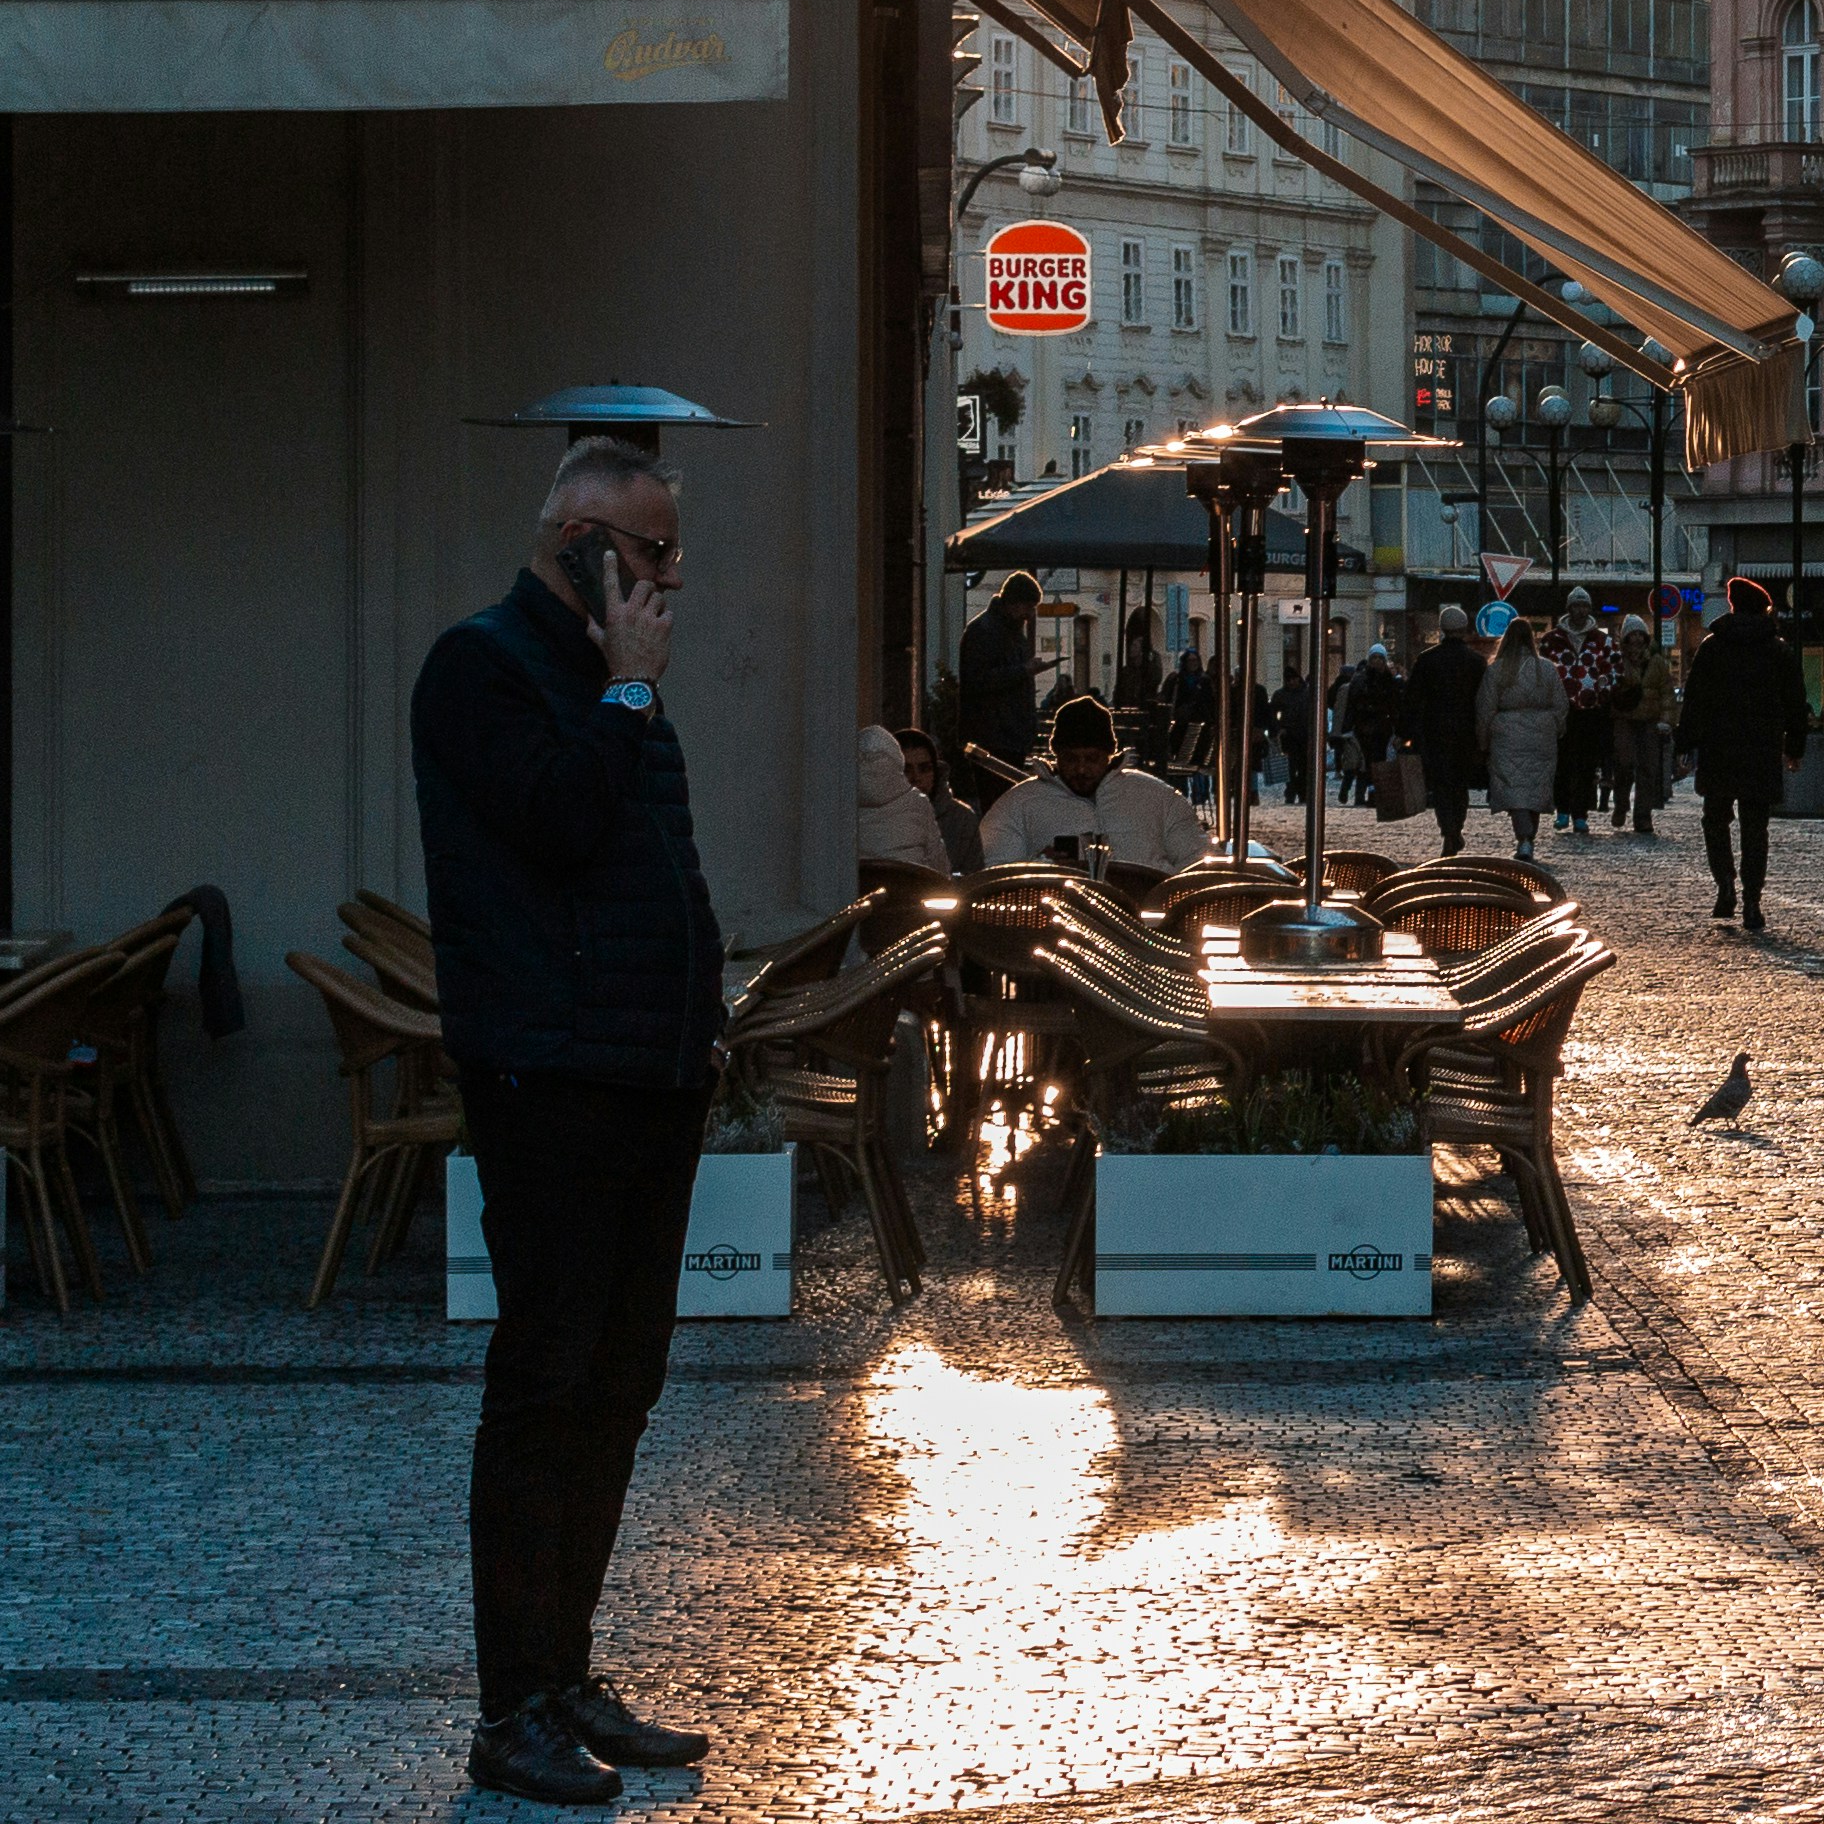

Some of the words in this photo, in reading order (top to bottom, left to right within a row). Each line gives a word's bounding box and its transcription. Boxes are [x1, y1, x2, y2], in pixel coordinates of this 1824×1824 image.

[604, 29, 728, 80] Budvar
[990, 258, 1086, 278] BURGER
[990, 280, 1086, 310] KING
[1265, 552, 1307, 566] BURGE
[688, 1255, 759, 1270] MARTINI
[1331, 1256, 1401, 1270] MARTINI
